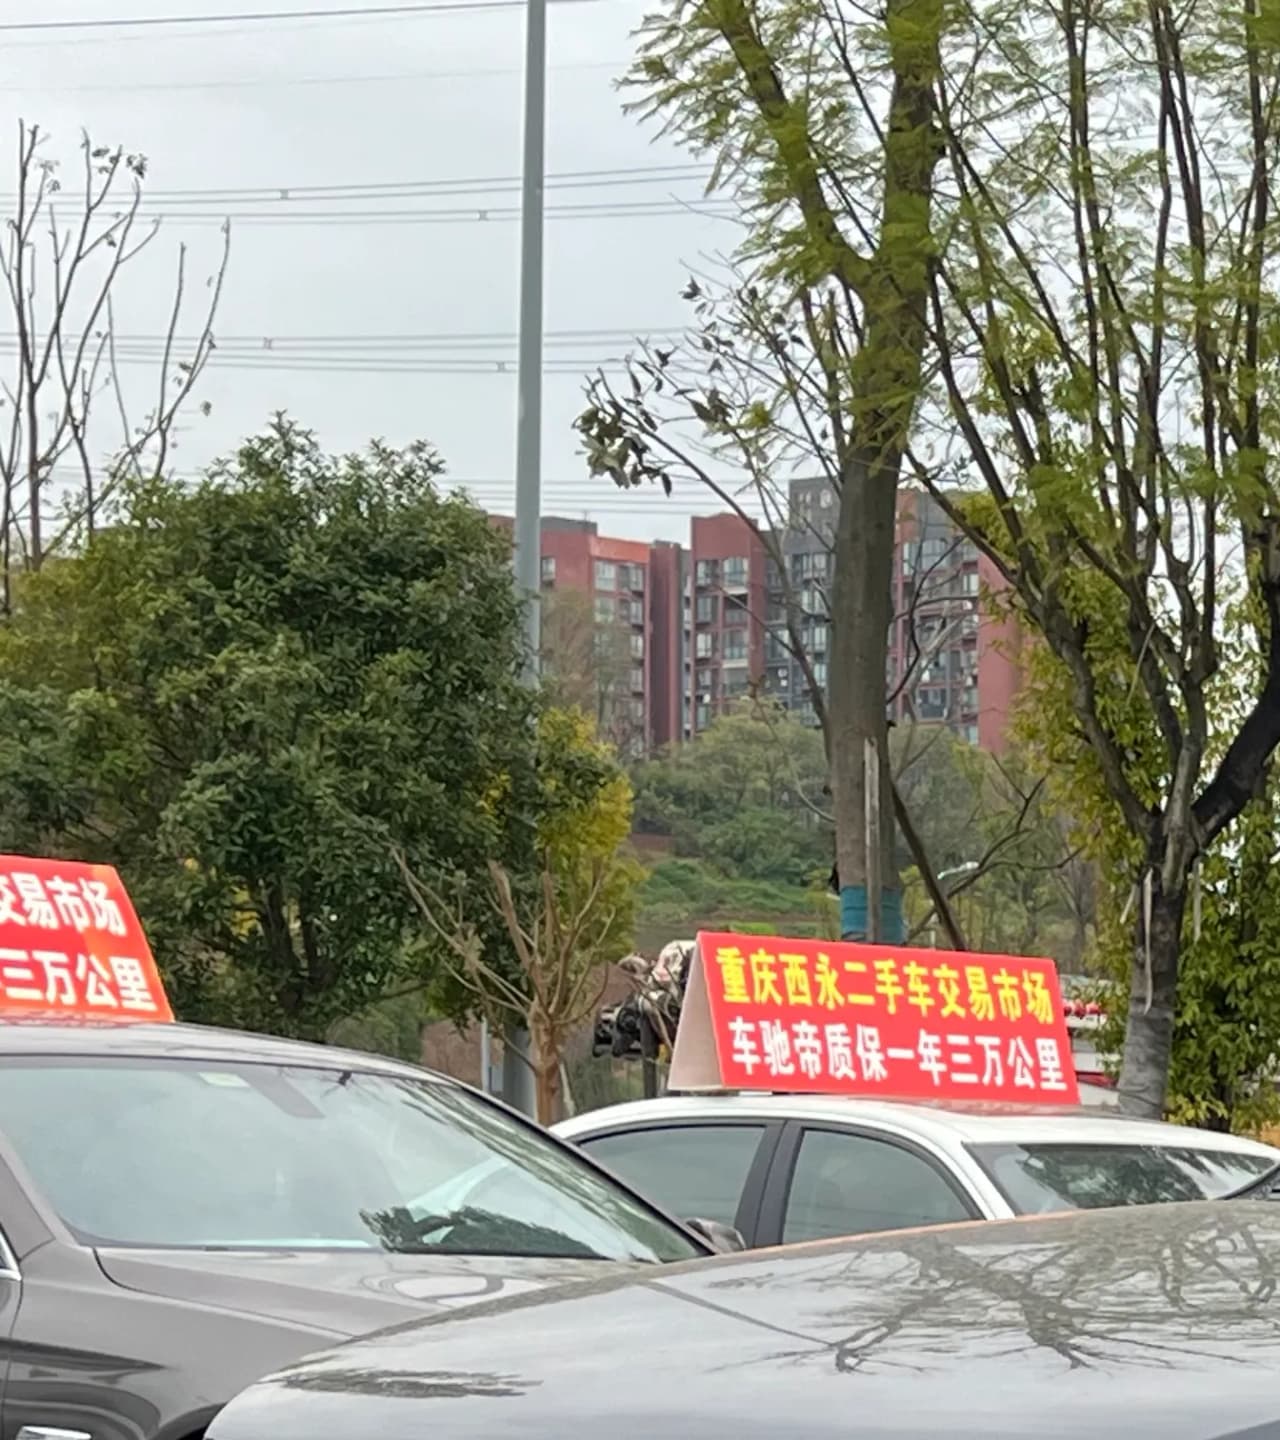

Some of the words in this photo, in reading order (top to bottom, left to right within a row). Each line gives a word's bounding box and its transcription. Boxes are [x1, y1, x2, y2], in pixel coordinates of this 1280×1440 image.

[716, 947, 1054, 1025] 重庆西永二手车交易市场
[728, 1015, 1068, 1091] 车驰帝质保一年三万公里
